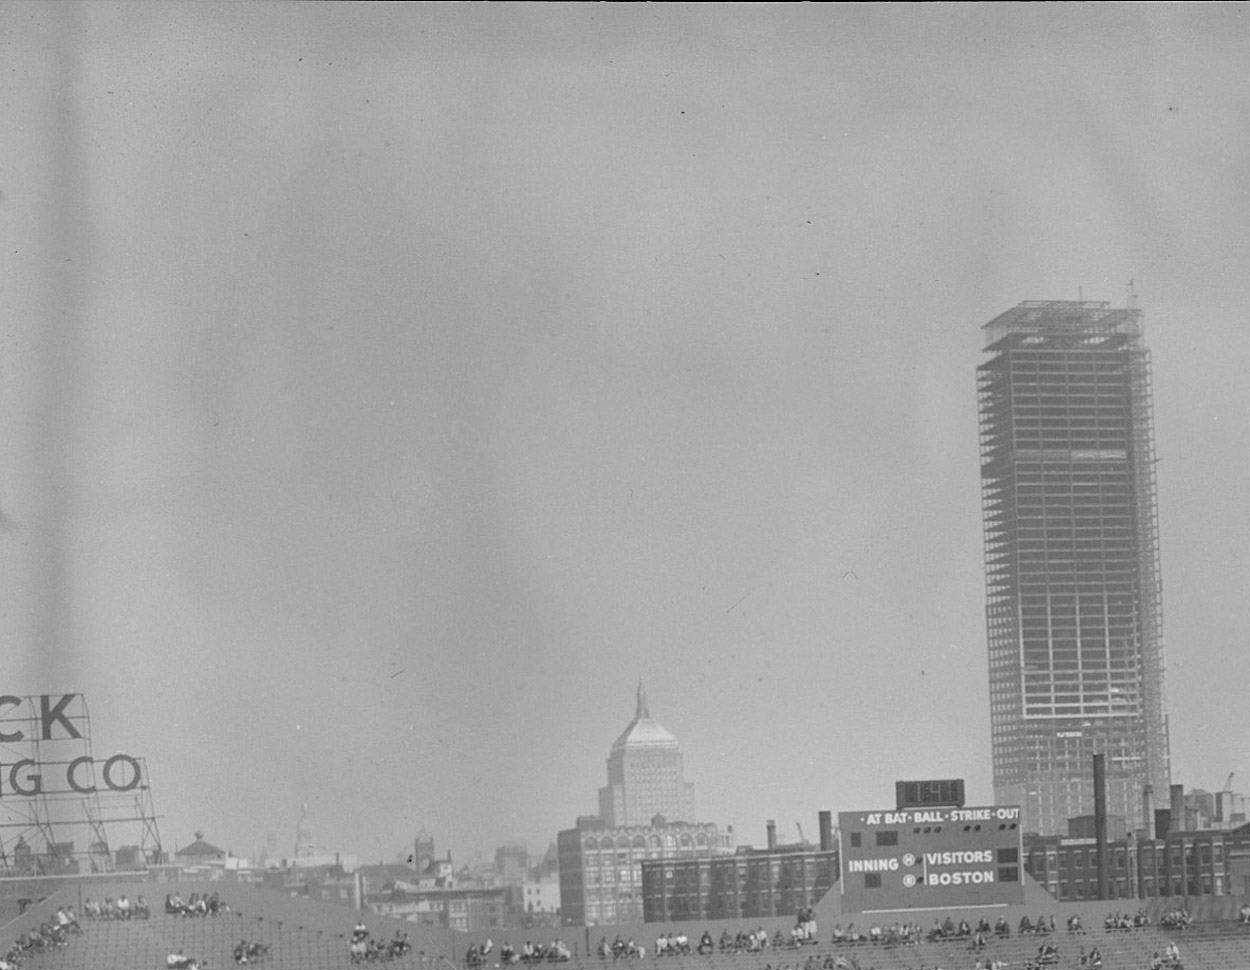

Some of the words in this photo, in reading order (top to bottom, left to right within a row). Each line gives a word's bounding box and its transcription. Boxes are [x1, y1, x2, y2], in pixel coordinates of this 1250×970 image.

[0, 758, 42, 797] G
[867, 813, 882, 825] AT
[884, 813, 908, 824] BAT
[914, 811, 944, 823] BALL
[951, 809, 991, 822] STRIKE
[997, 808, 1020, 819] OUT
[848, 858, 899, 872] INNING
[927, 850, 993, 865] VISITORS
[929, 871, 994, 886] BOSTON
